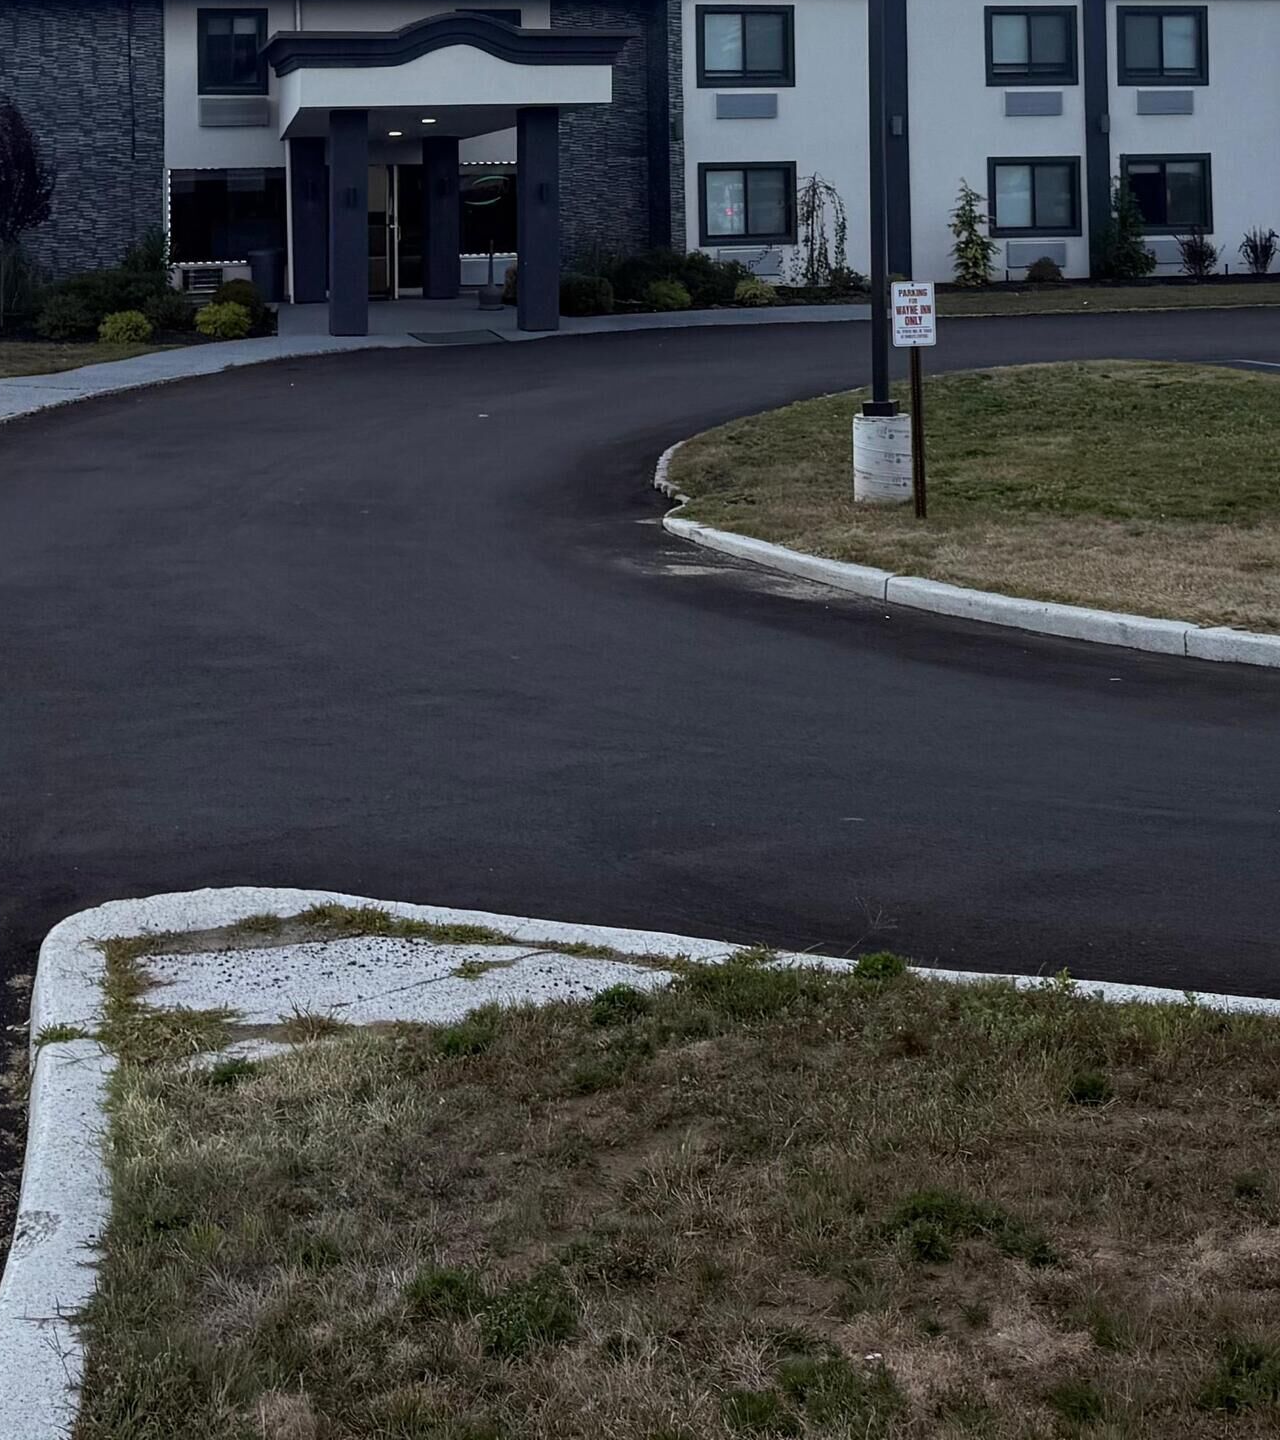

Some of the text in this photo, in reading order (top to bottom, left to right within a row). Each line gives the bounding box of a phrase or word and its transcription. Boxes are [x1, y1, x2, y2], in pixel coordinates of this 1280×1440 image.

[898, 288, 928, 297] PARKING
[896, 305, 931, 315] WAYNE INN
[905, 316, 922, 326] ONLY
